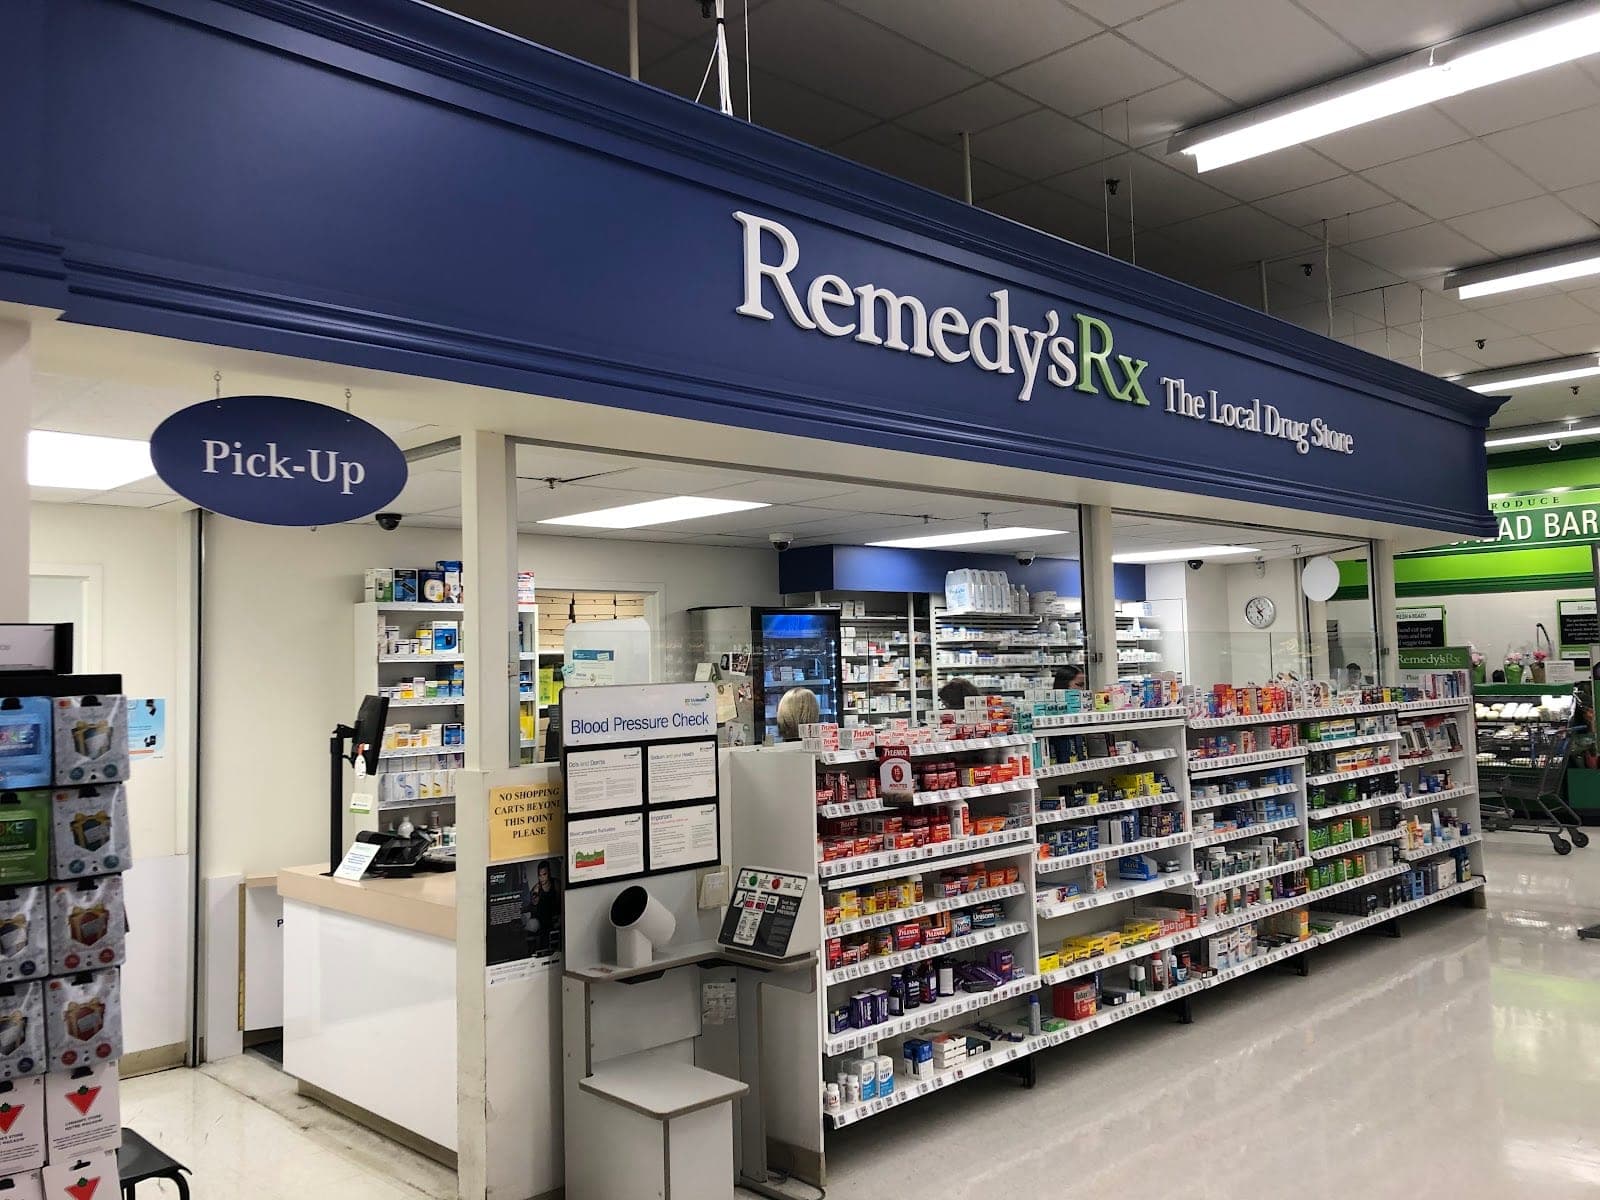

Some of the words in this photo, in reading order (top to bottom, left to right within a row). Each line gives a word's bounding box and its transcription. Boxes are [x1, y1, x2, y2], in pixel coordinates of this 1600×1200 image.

[1160, 376, 1206, 419] The
[1208, 390, 1262, 432] Local
[1264, 404, 1310, 454] Drug
[1311, 418, 1354, 455] Store
[202, 439, 366, 495] Pick-Up
[1491, 496, 1560, 509] RODUCE
[1494, 514, 1533, 541] AD
[1544, 509, 1599, 538] BAR
[571, 718, 609, 735] Blood
[613, 715, 669, 732] Pressure
[672, 711, 709, 729] Check
[499, 793, 512, 801] NO
[514, 788, 560, 800] SHOPPING
[494, 805, 524, 815] CARTS
[504, 817, 525, 827] THIS
[527, 812, 554, 824] POINT
[513, 827, 546, 839] PLEASE
[277, 918, 284, 928] P
